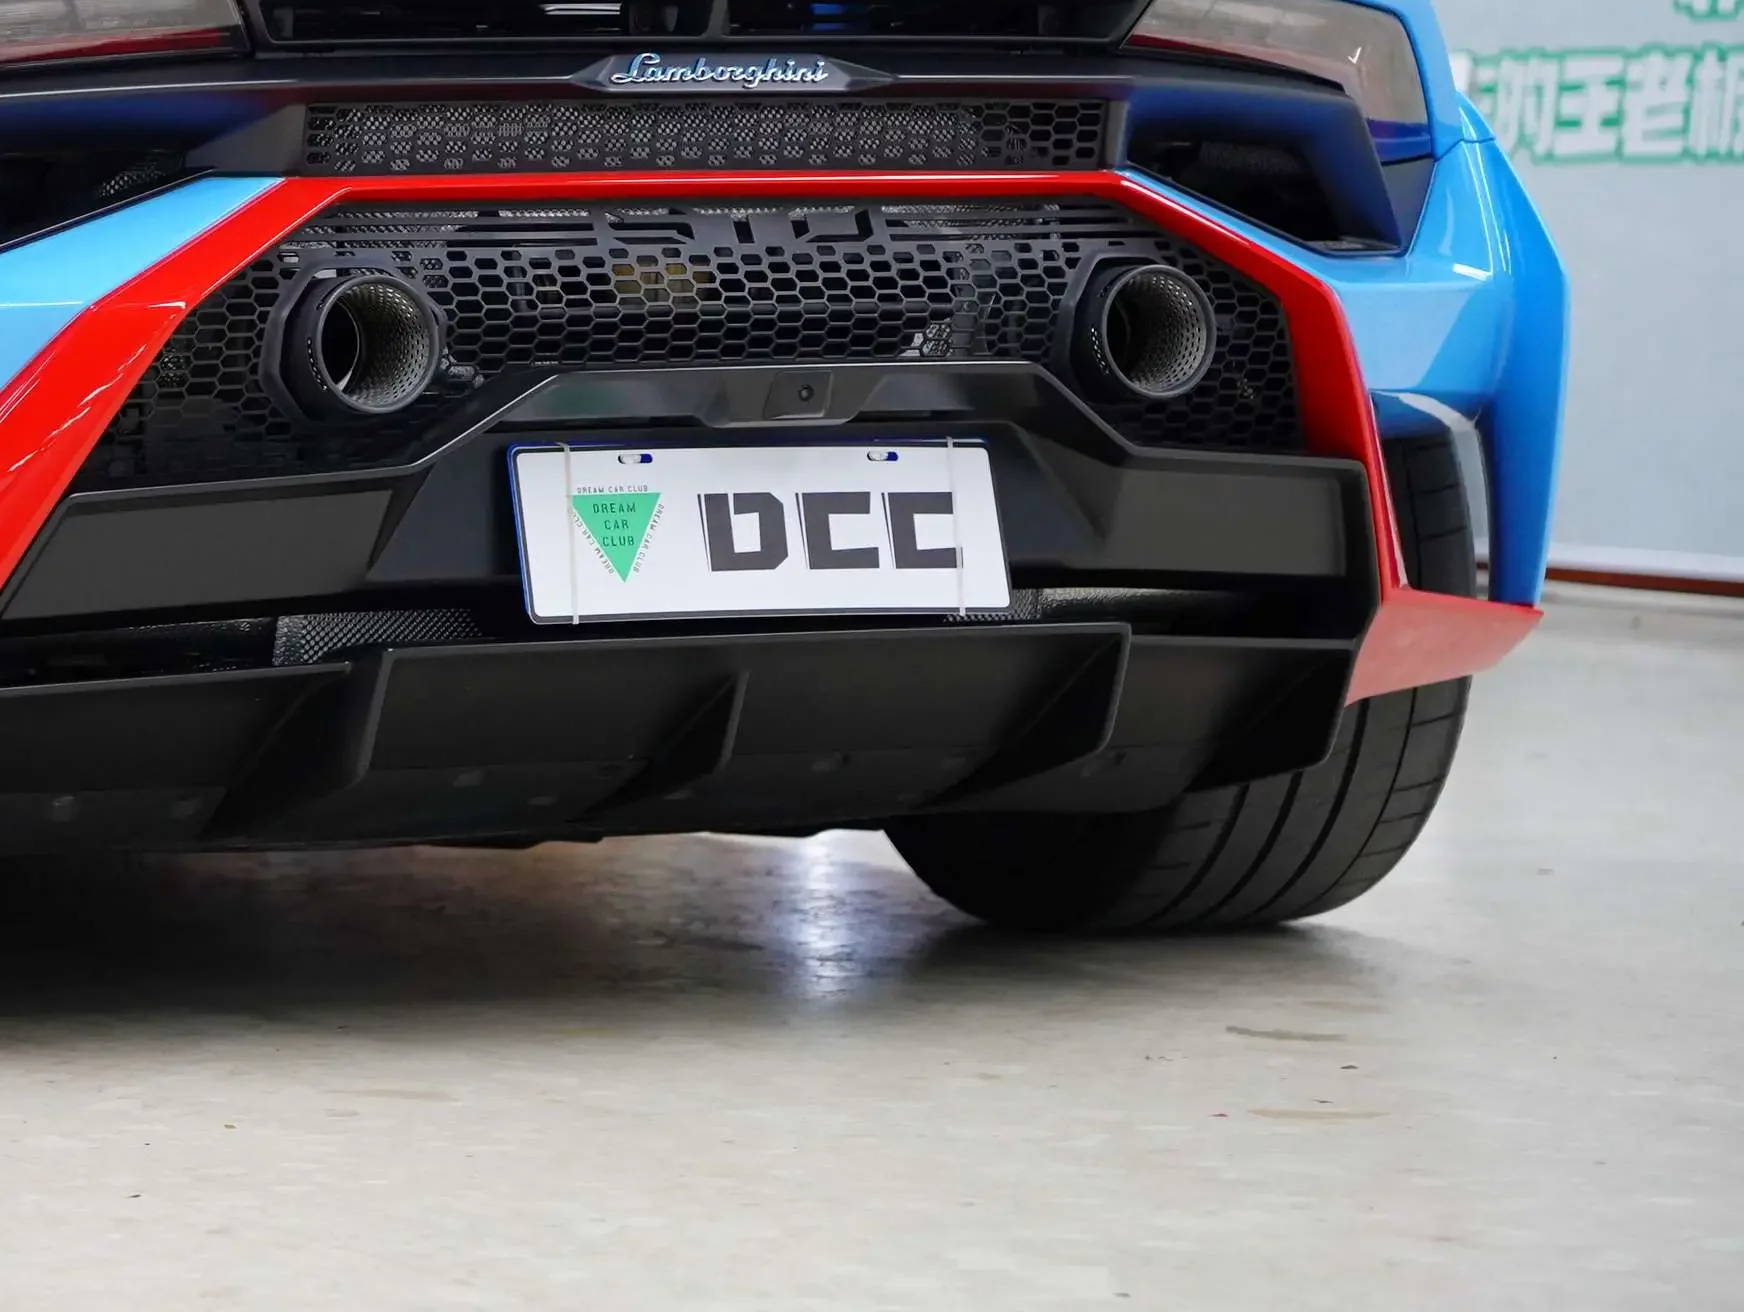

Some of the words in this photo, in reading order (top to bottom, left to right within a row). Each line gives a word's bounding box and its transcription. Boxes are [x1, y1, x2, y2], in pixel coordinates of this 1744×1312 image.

[611, 52, 829, 88] Lamborghini
[577, 486, 604, 494] DREAM
[628, 484, 648, 492] CLUB
[593, 502, 636, 514] DREAM
[604, 519, 630, 530] CAR
[697, 491, 963, 572] DCC
[602, 535, 635, 547] CLUB
